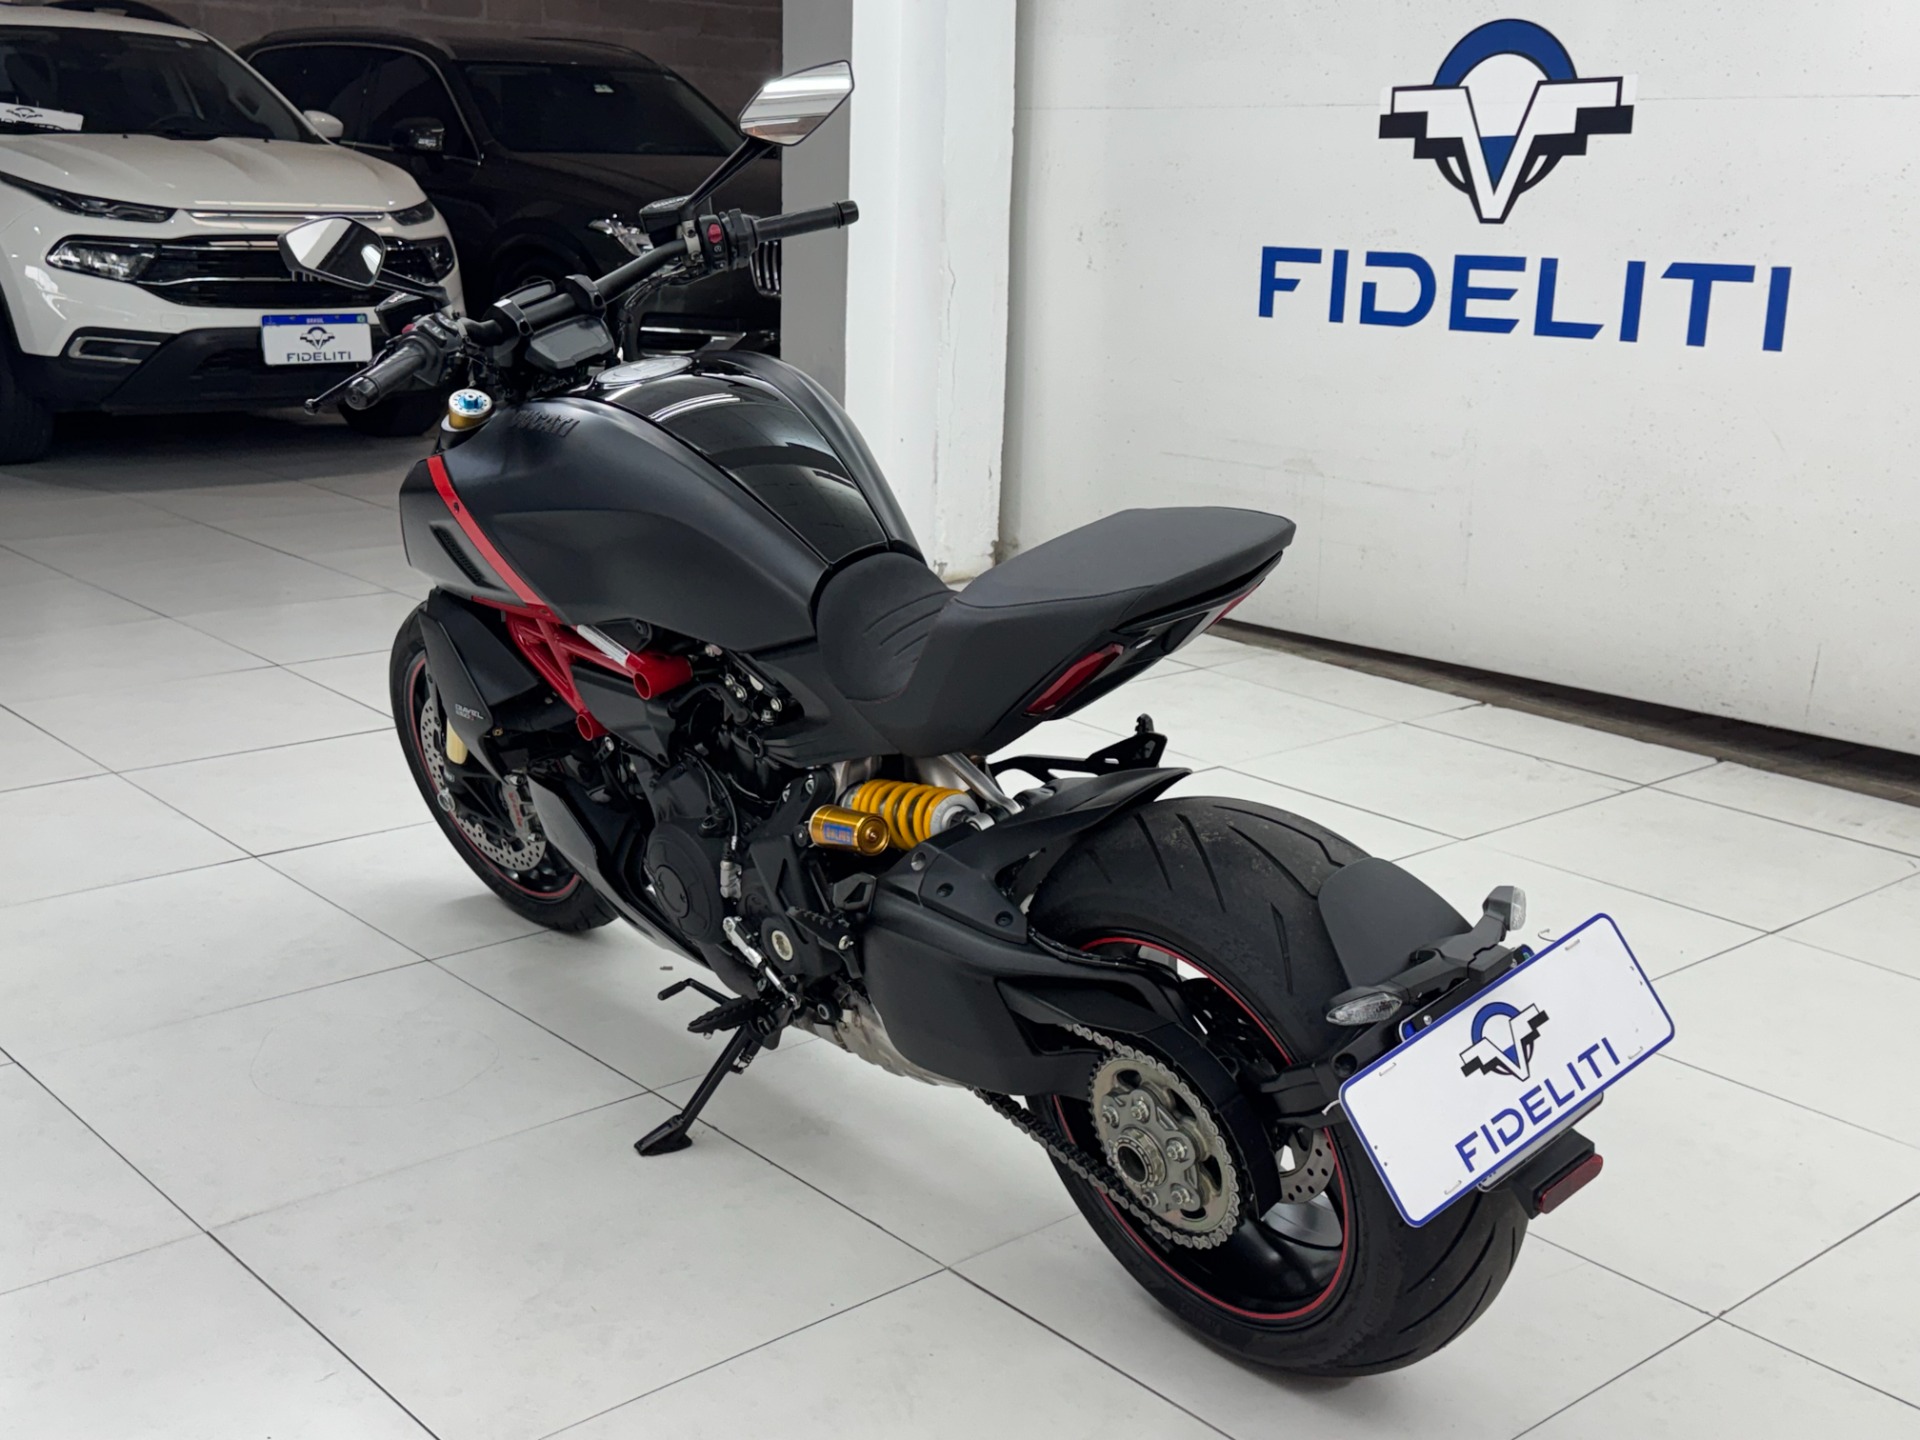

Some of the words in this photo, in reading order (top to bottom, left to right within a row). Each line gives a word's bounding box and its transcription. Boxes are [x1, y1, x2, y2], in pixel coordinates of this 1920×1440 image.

[1258, 246, 1792, 351] FIDELITI
[286, 351, 352, 362] FIDELITI
[1454, 1037, 1621, 1173] FIDELITI
